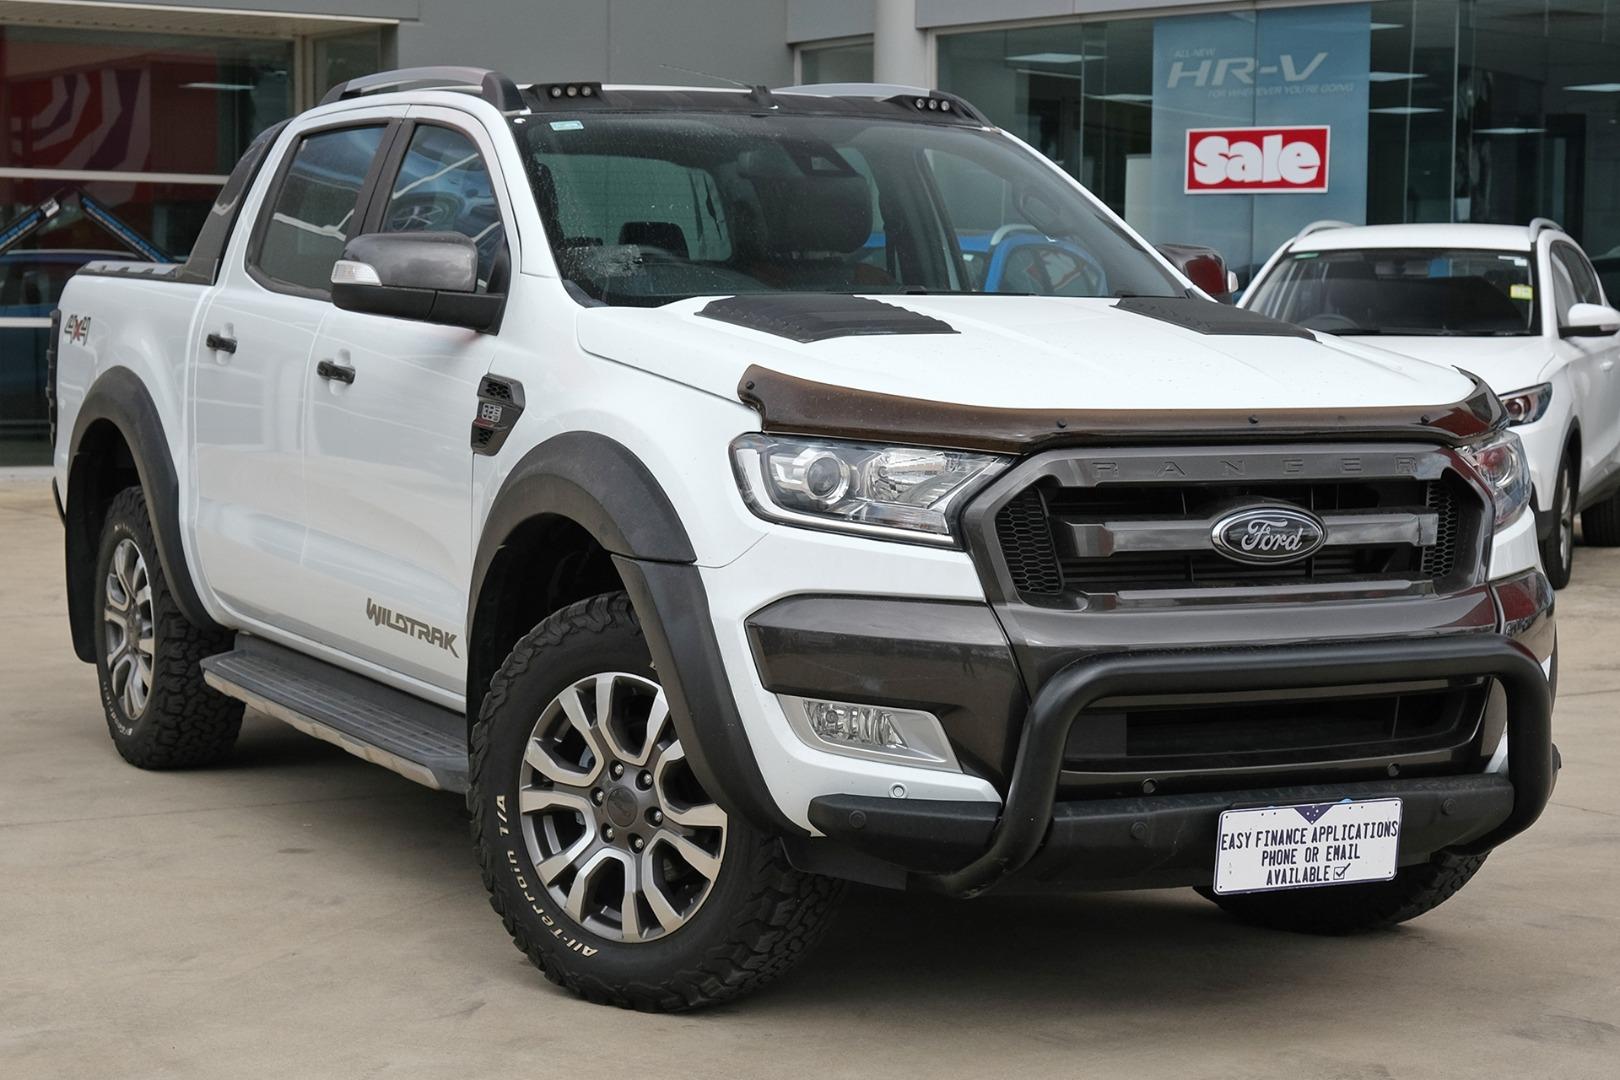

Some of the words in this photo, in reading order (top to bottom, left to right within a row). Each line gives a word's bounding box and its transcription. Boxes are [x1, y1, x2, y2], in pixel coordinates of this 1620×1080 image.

[1167, 52, 1329, 88] HR-V
[1193, 134, 1321, 185] Sale
[1092, 455, 1418, 479] RANGER
[1240, 518, 1304, 552] Ford
[366, 597, 460, 659] WILDTRAK
[1221, 832, 1252, 851] EASY
[1255, 828, 1308, 848] FINANCE
[1311, 820, 1399, 843] APPLICATIONS
[1261, 848, 1298, 867] PHONE
[1305, 847, 1320, 863] OR
[1326, 843, 1361, 862] EMAIL
[1266, 865, 1331, 886] AVAILABLE
